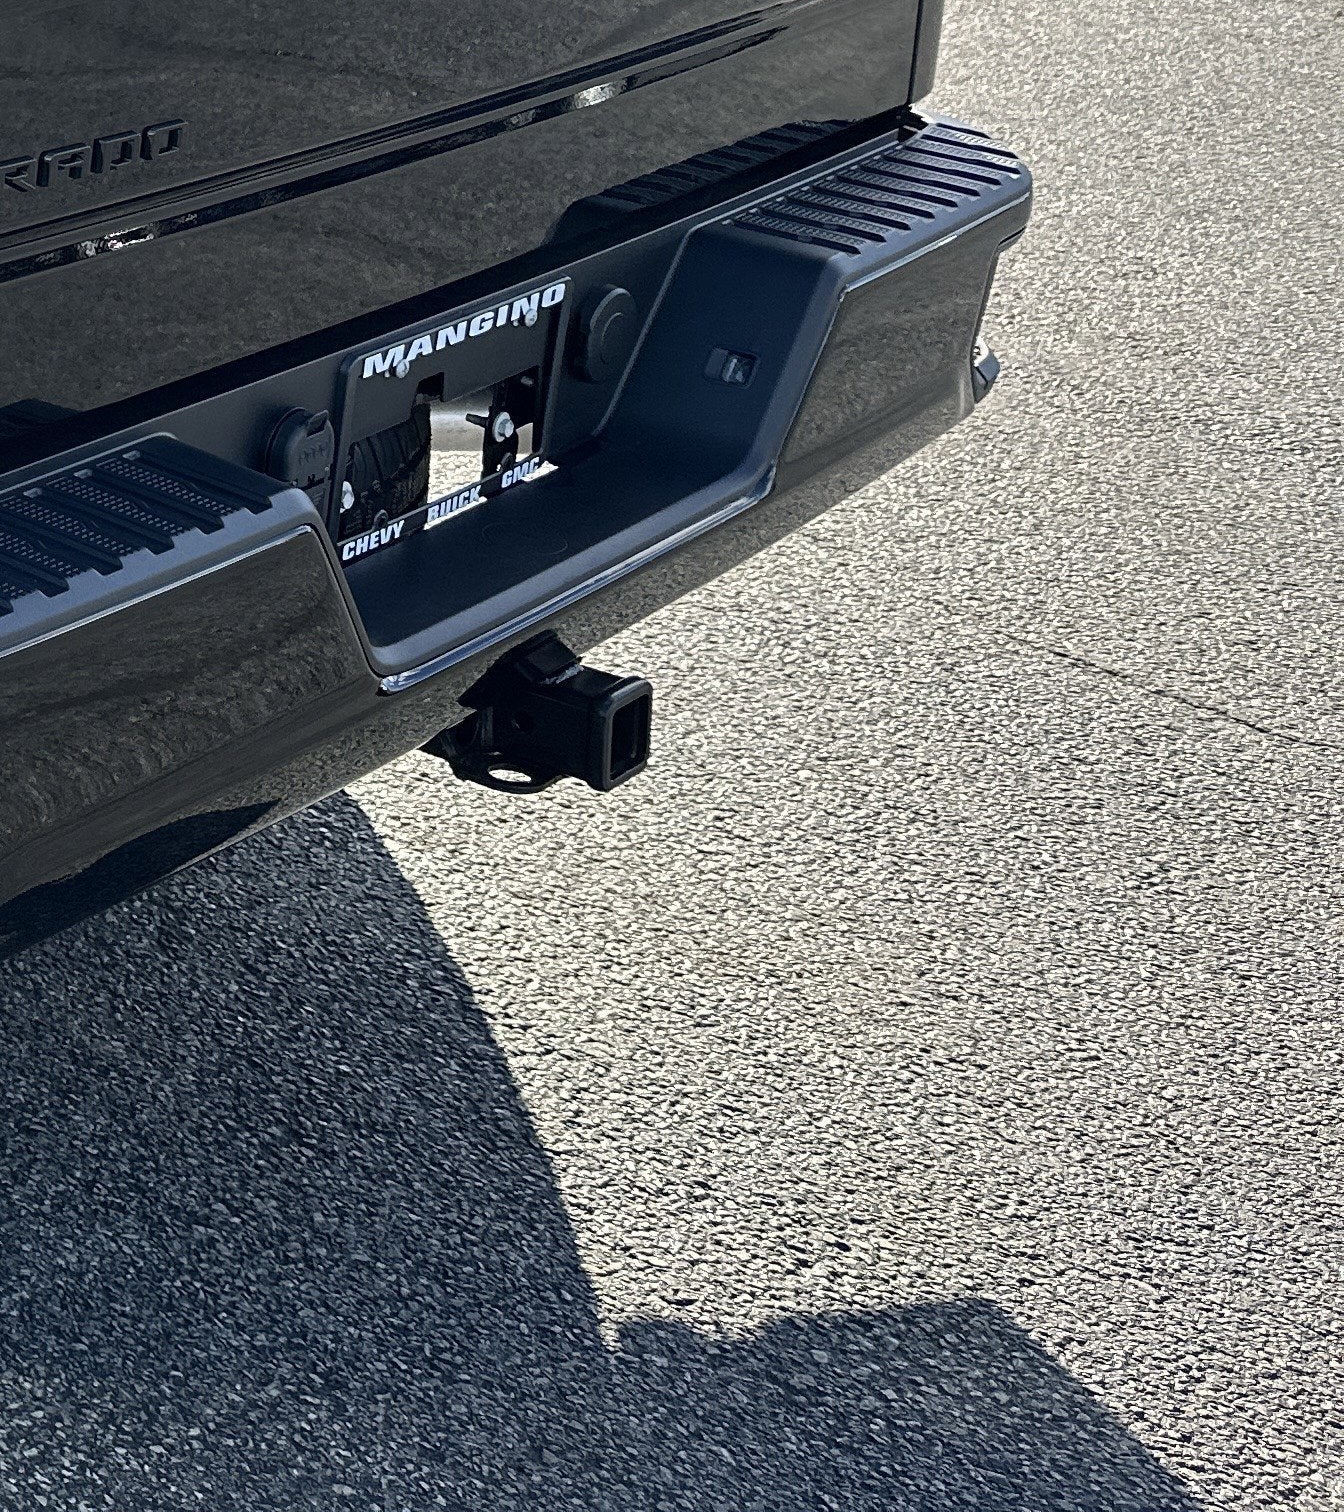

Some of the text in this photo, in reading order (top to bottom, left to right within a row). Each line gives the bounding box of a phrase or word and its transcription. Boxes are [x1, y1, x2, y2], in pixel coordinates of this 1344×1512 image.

[362, 283, 566, 378] MANGINO
[341, 519, 406, 561] CHEVY
[501, 456, 540, 489] GMC
